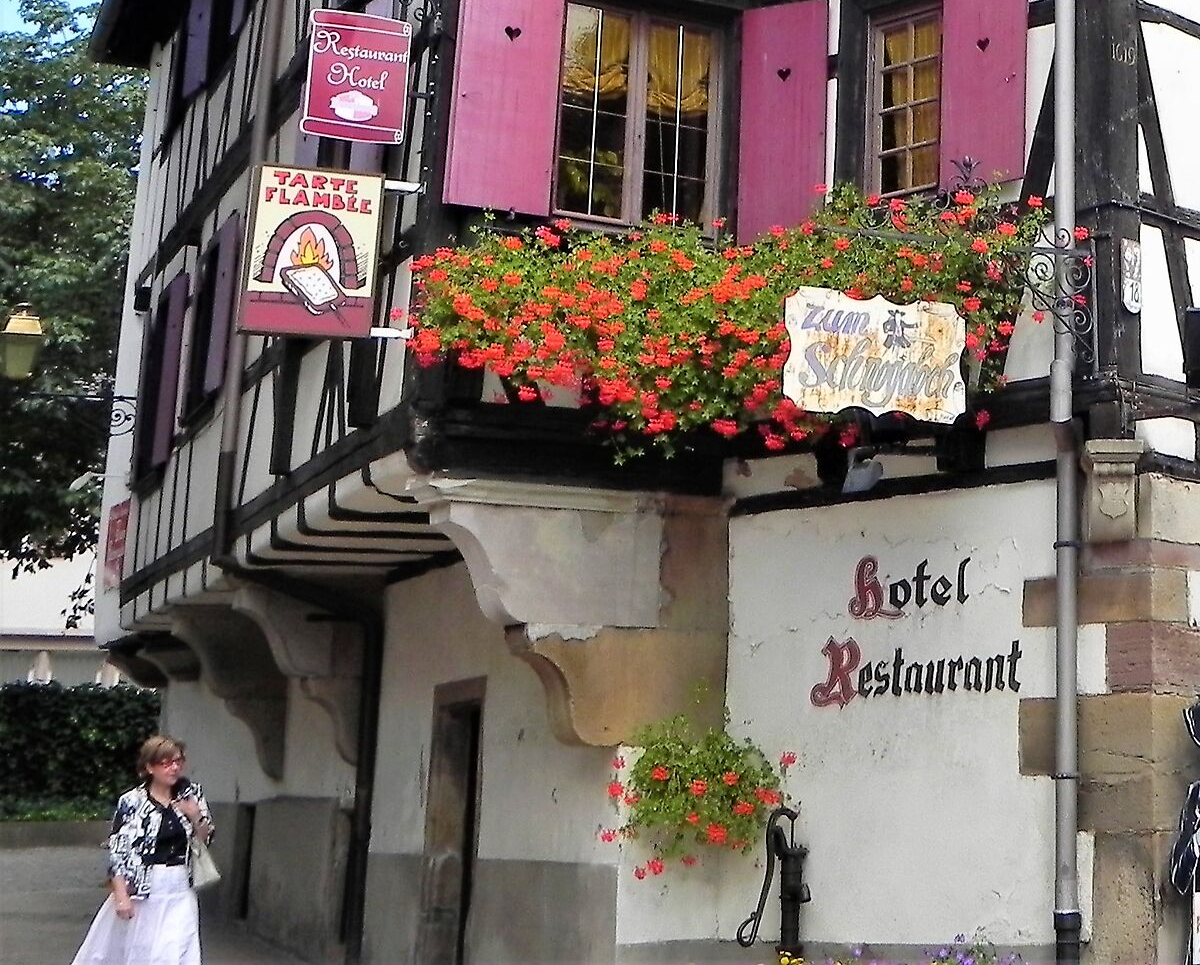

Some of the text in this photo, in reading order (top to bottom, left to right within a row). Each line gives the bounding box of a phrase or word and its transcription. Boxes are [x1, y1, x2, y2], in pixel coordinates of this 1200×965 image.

[313, 30, 408, 64] Restaurant
[327, 62, 390, 90] Hotel
[274, 170, 358, 195] TARTE
[265, 186, 373, 215] FLAMBÉE
[1130, 282, 1139, 303] 18
[848, 555, 972, 620] Hotel
[810, 636, 1023, 709] Restaurant
